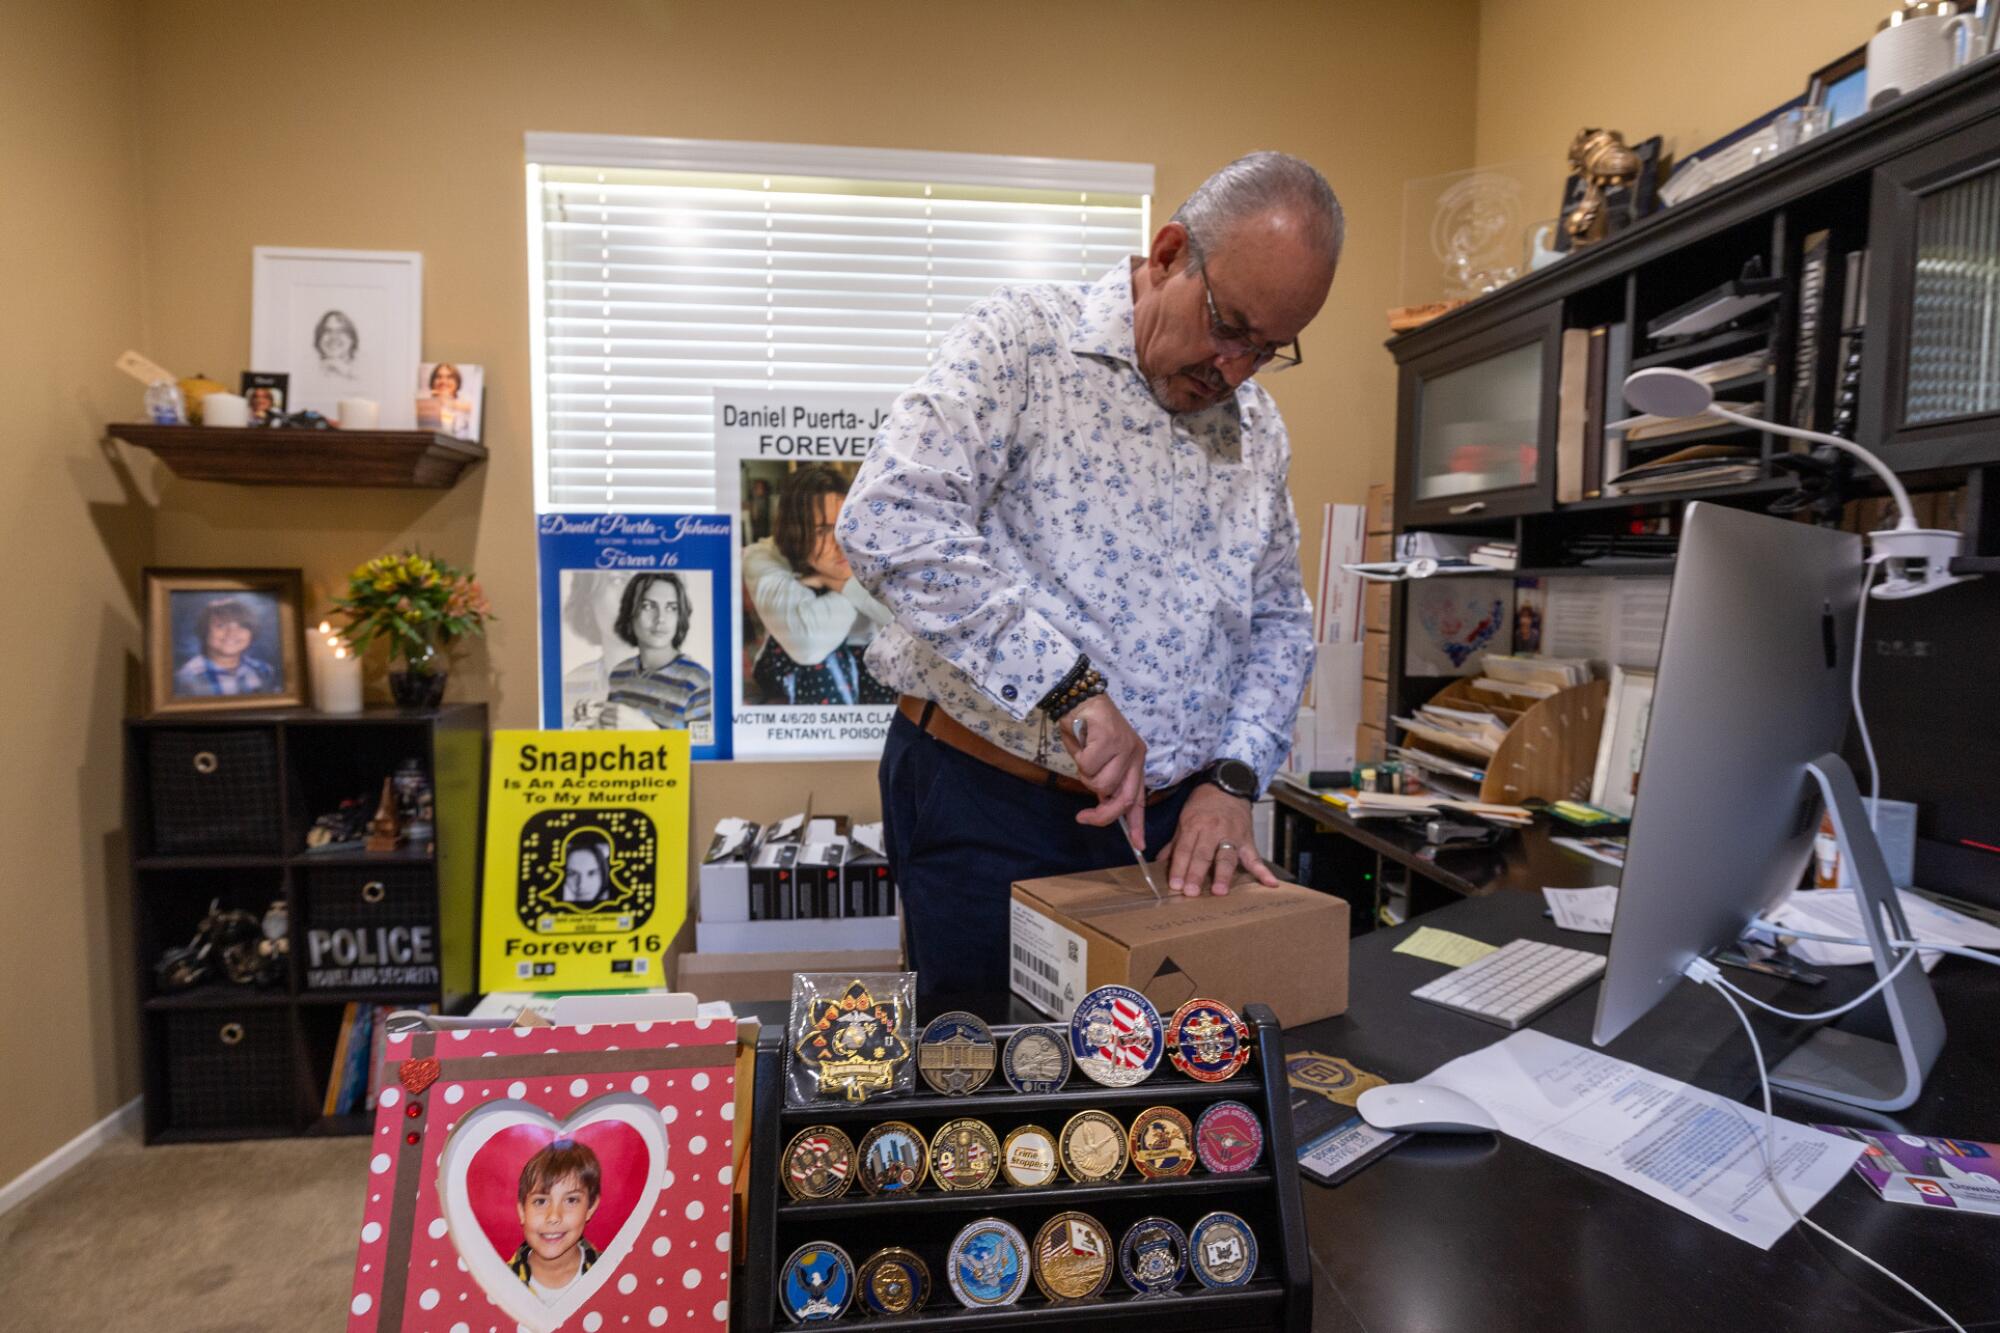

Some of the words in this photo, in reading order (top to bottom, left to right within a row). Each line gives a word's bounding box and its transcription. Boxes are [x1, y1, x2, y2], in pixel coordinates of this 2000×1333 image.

[723, 405, 786, 428] Daniel
[540, 514, 597, 535] Daniel
[595, 547, 657, 568] Forever
[660, 552, 679, 567] 16
[820, 712, 863, 724] SANTA
[768, 728, 836, 740] FENTANYL
[519, 744, 668, 778] Snapchat
[503, 778, 517, 789] Is
[528, 778, 554, 789] An
[562, 777, 678, 791] Accomplice
[523, 792, 547, 804] To
[553, 792, 581, 805] My
[588, 791, 659, 804] Murder
[307, 925, 435, 968] POLICE
[505, 938, 617, 956] Forever
[628, 935, 662, 953] 16
[1096, 988, 1147, 1008] OPERATIONS
[940, 1151, 953, 1169] 9
